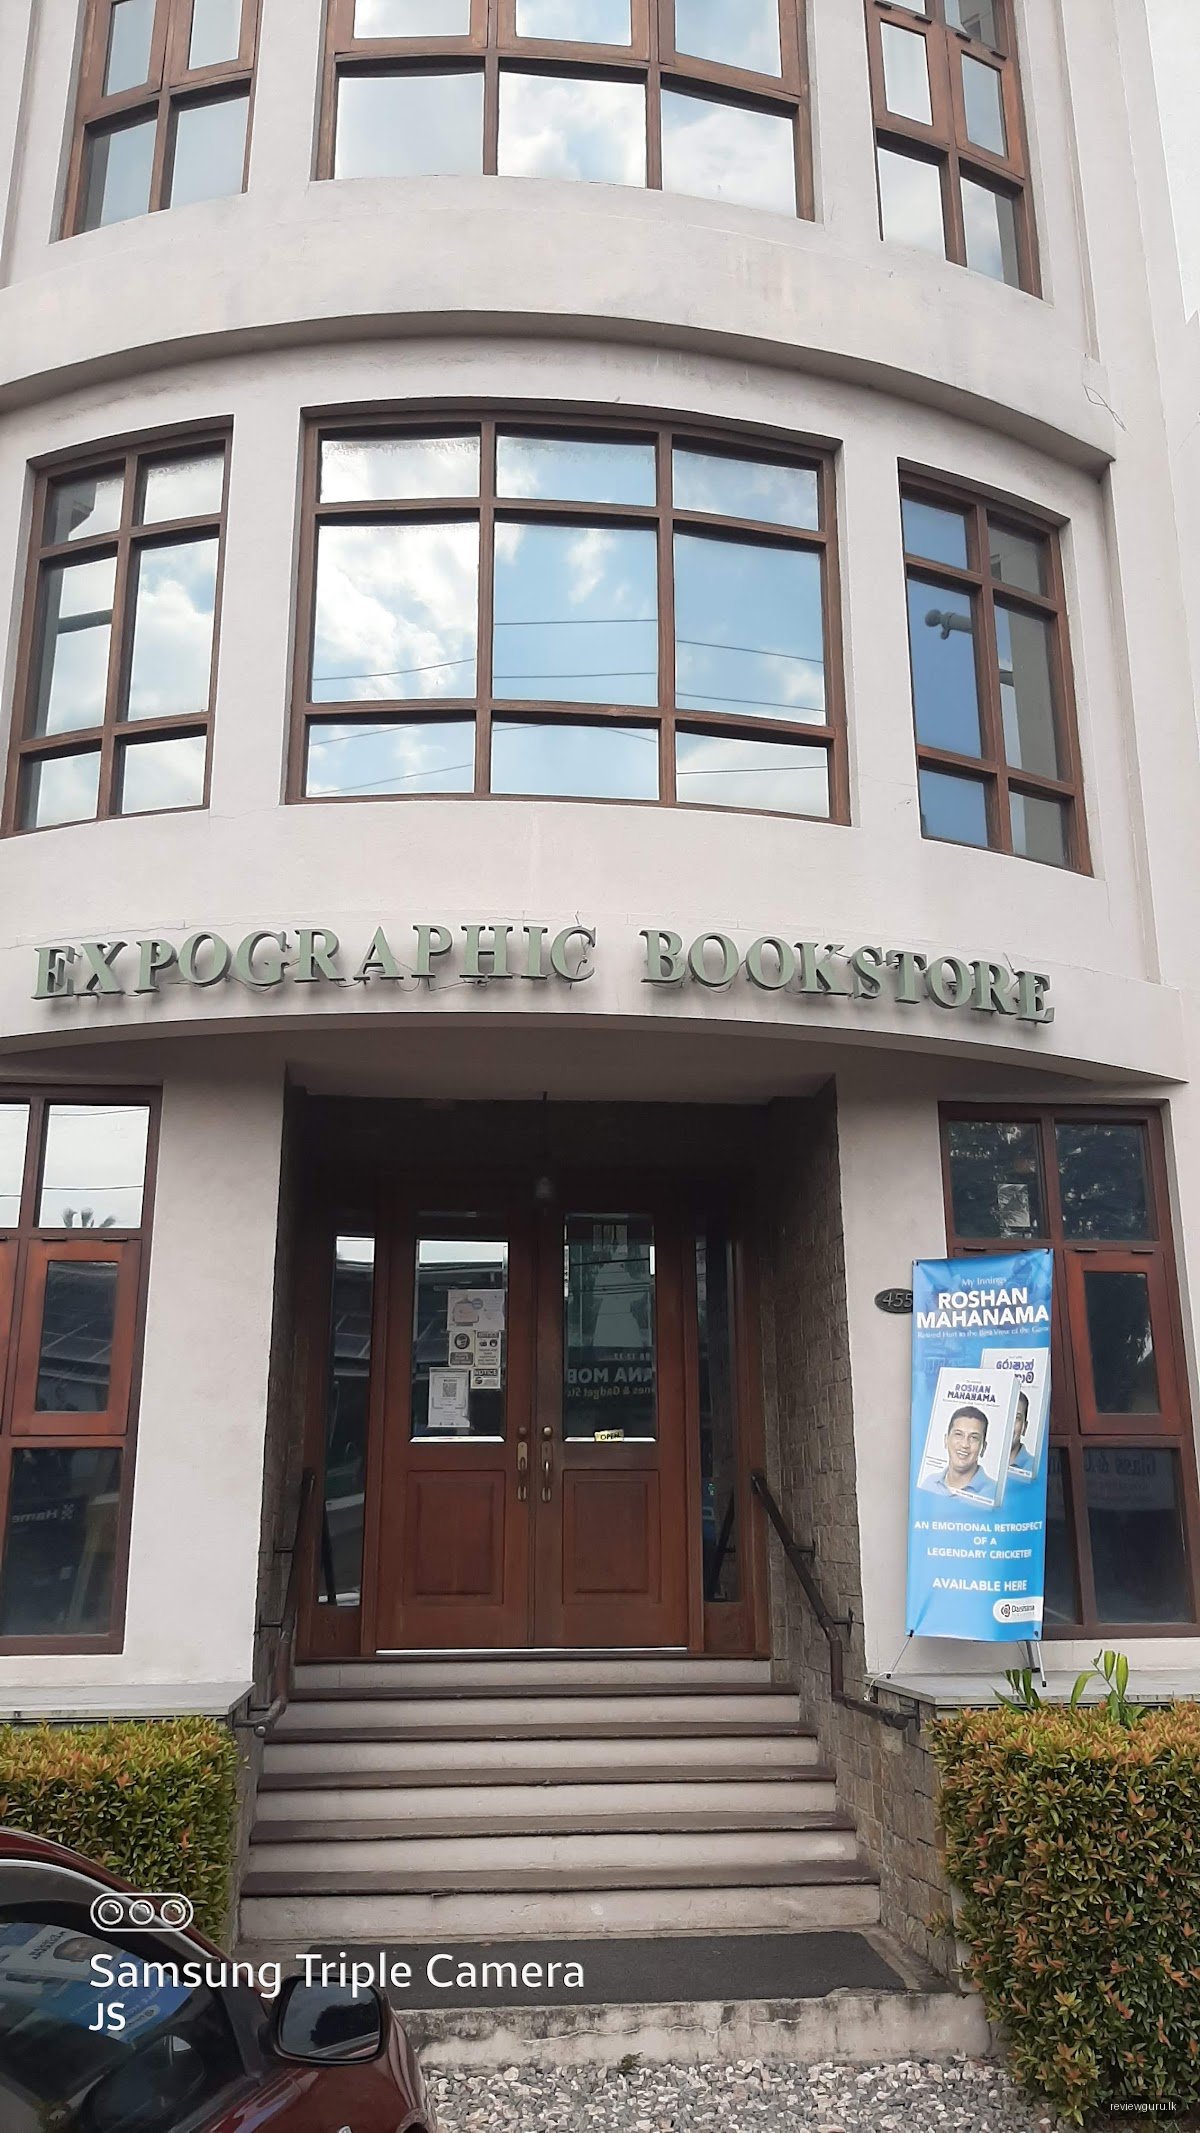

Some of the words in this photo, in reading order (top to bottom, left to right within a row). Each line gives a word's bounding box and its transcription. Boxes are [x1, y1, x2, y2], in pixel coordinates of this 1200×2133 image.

[31, 925, 597, 1000] EXPOGRAPHIC
[639, 929, 1056, 1023] BOOKSTORE
[961, 1278, 974, 1288] My
[977, 1276, 1007, 1287] Innings
[882, 1292, 912, 1308] 455
[938, 1287, 1028, 1310] ROSHAN
[916, 1305, 1049, 1329] MAHANAMA
[955, 1383, 992, 1394] ROSHAN
[947, 1390, 996, 1403] MAHANAMA
[600, 1432, 621, 1440] OPEN
[914, 1521, 929, 1530] AN
[932, 1521, 992, 1532] EMOTIONAL
[994, 1521, 1043, 1532] RETROSPECT
[973, 1536, 988, 1545] OF
[990, 1537, 998, 1545] A
[927, 1547, 987, 1559] LEGENDARY
[989, 1548, 1032, 1559] CRICKETER
[932, 1577, 1001, 1592] AVAILABLE
[1004, 1579, 1028, 1592] HERE
